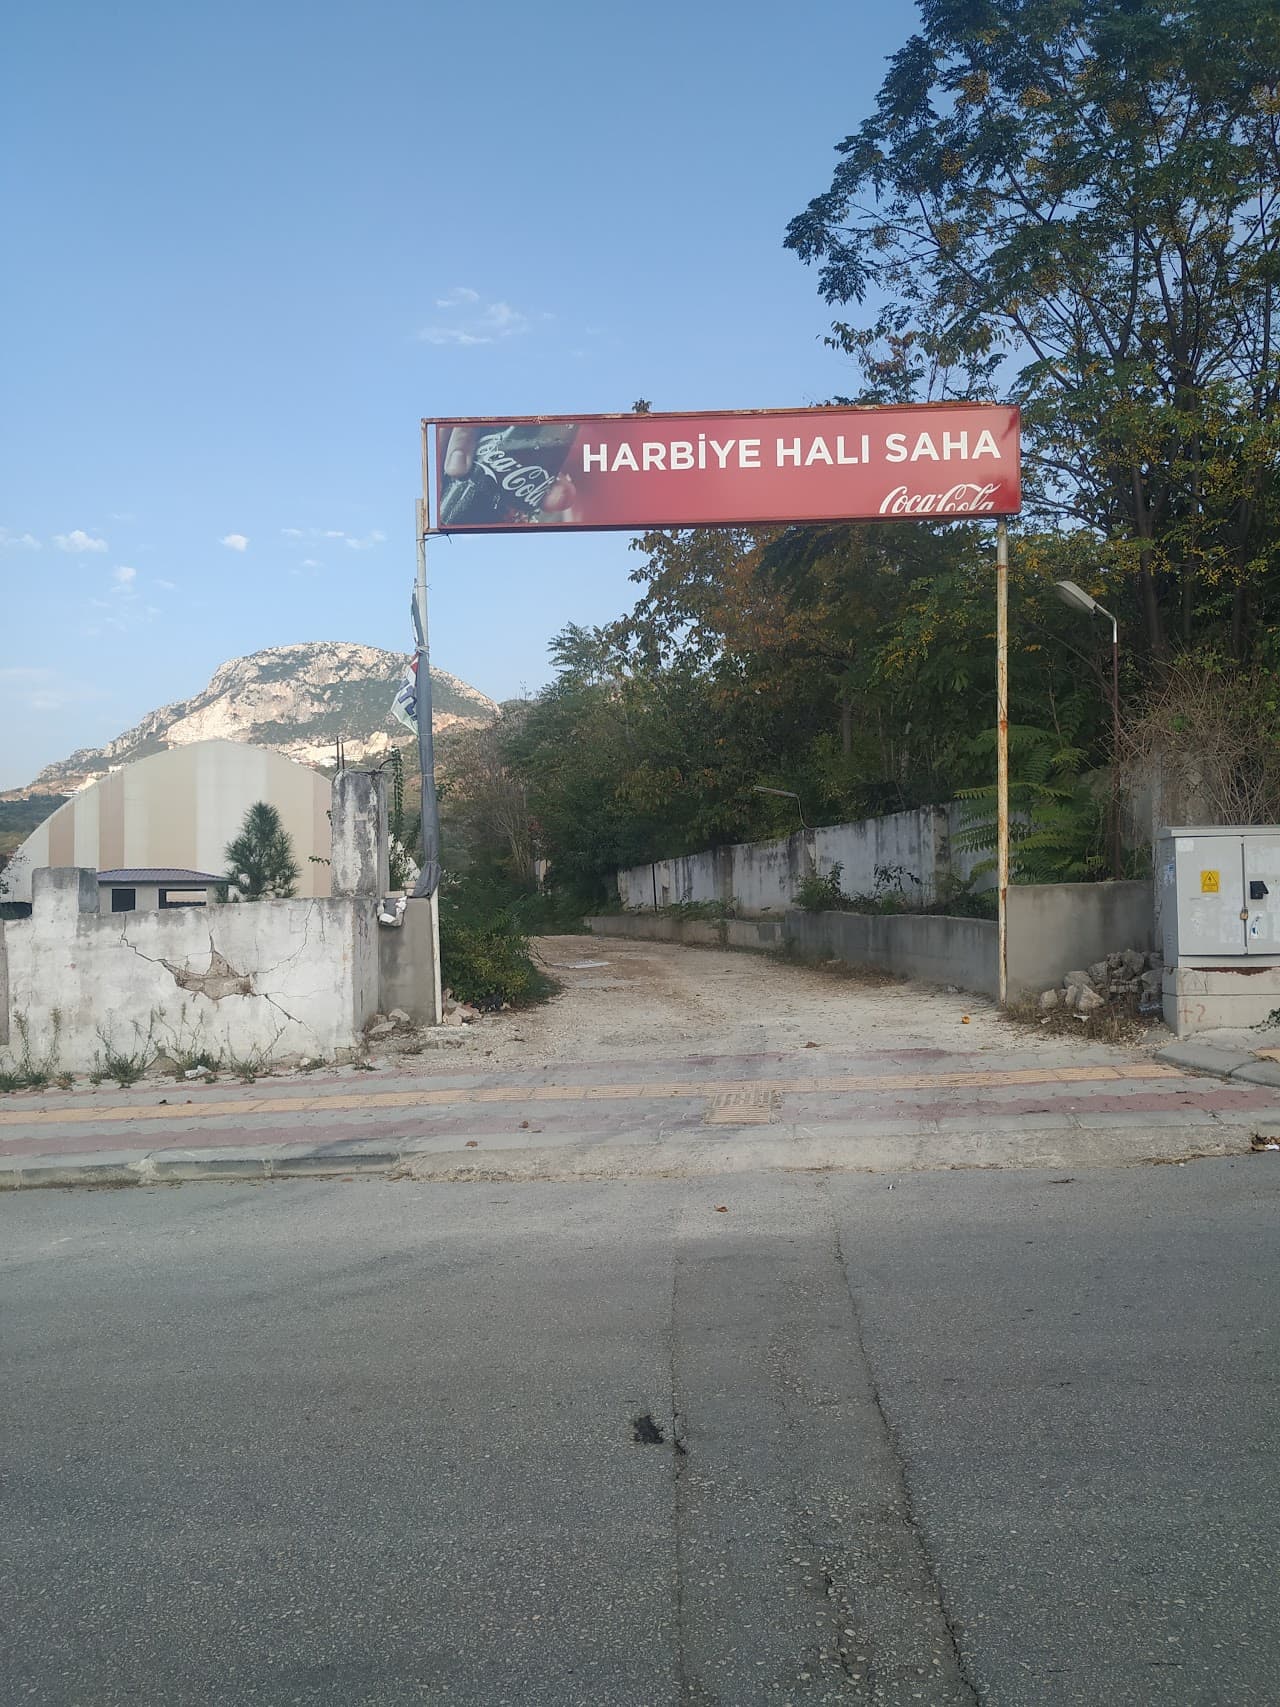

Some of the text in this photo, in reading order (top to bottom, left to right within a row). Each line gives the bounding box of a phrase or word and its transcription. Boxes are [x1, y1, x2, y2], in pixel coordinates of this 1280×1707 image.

[583, 429, 1001, 473] HARBİYE HALI SAHA
